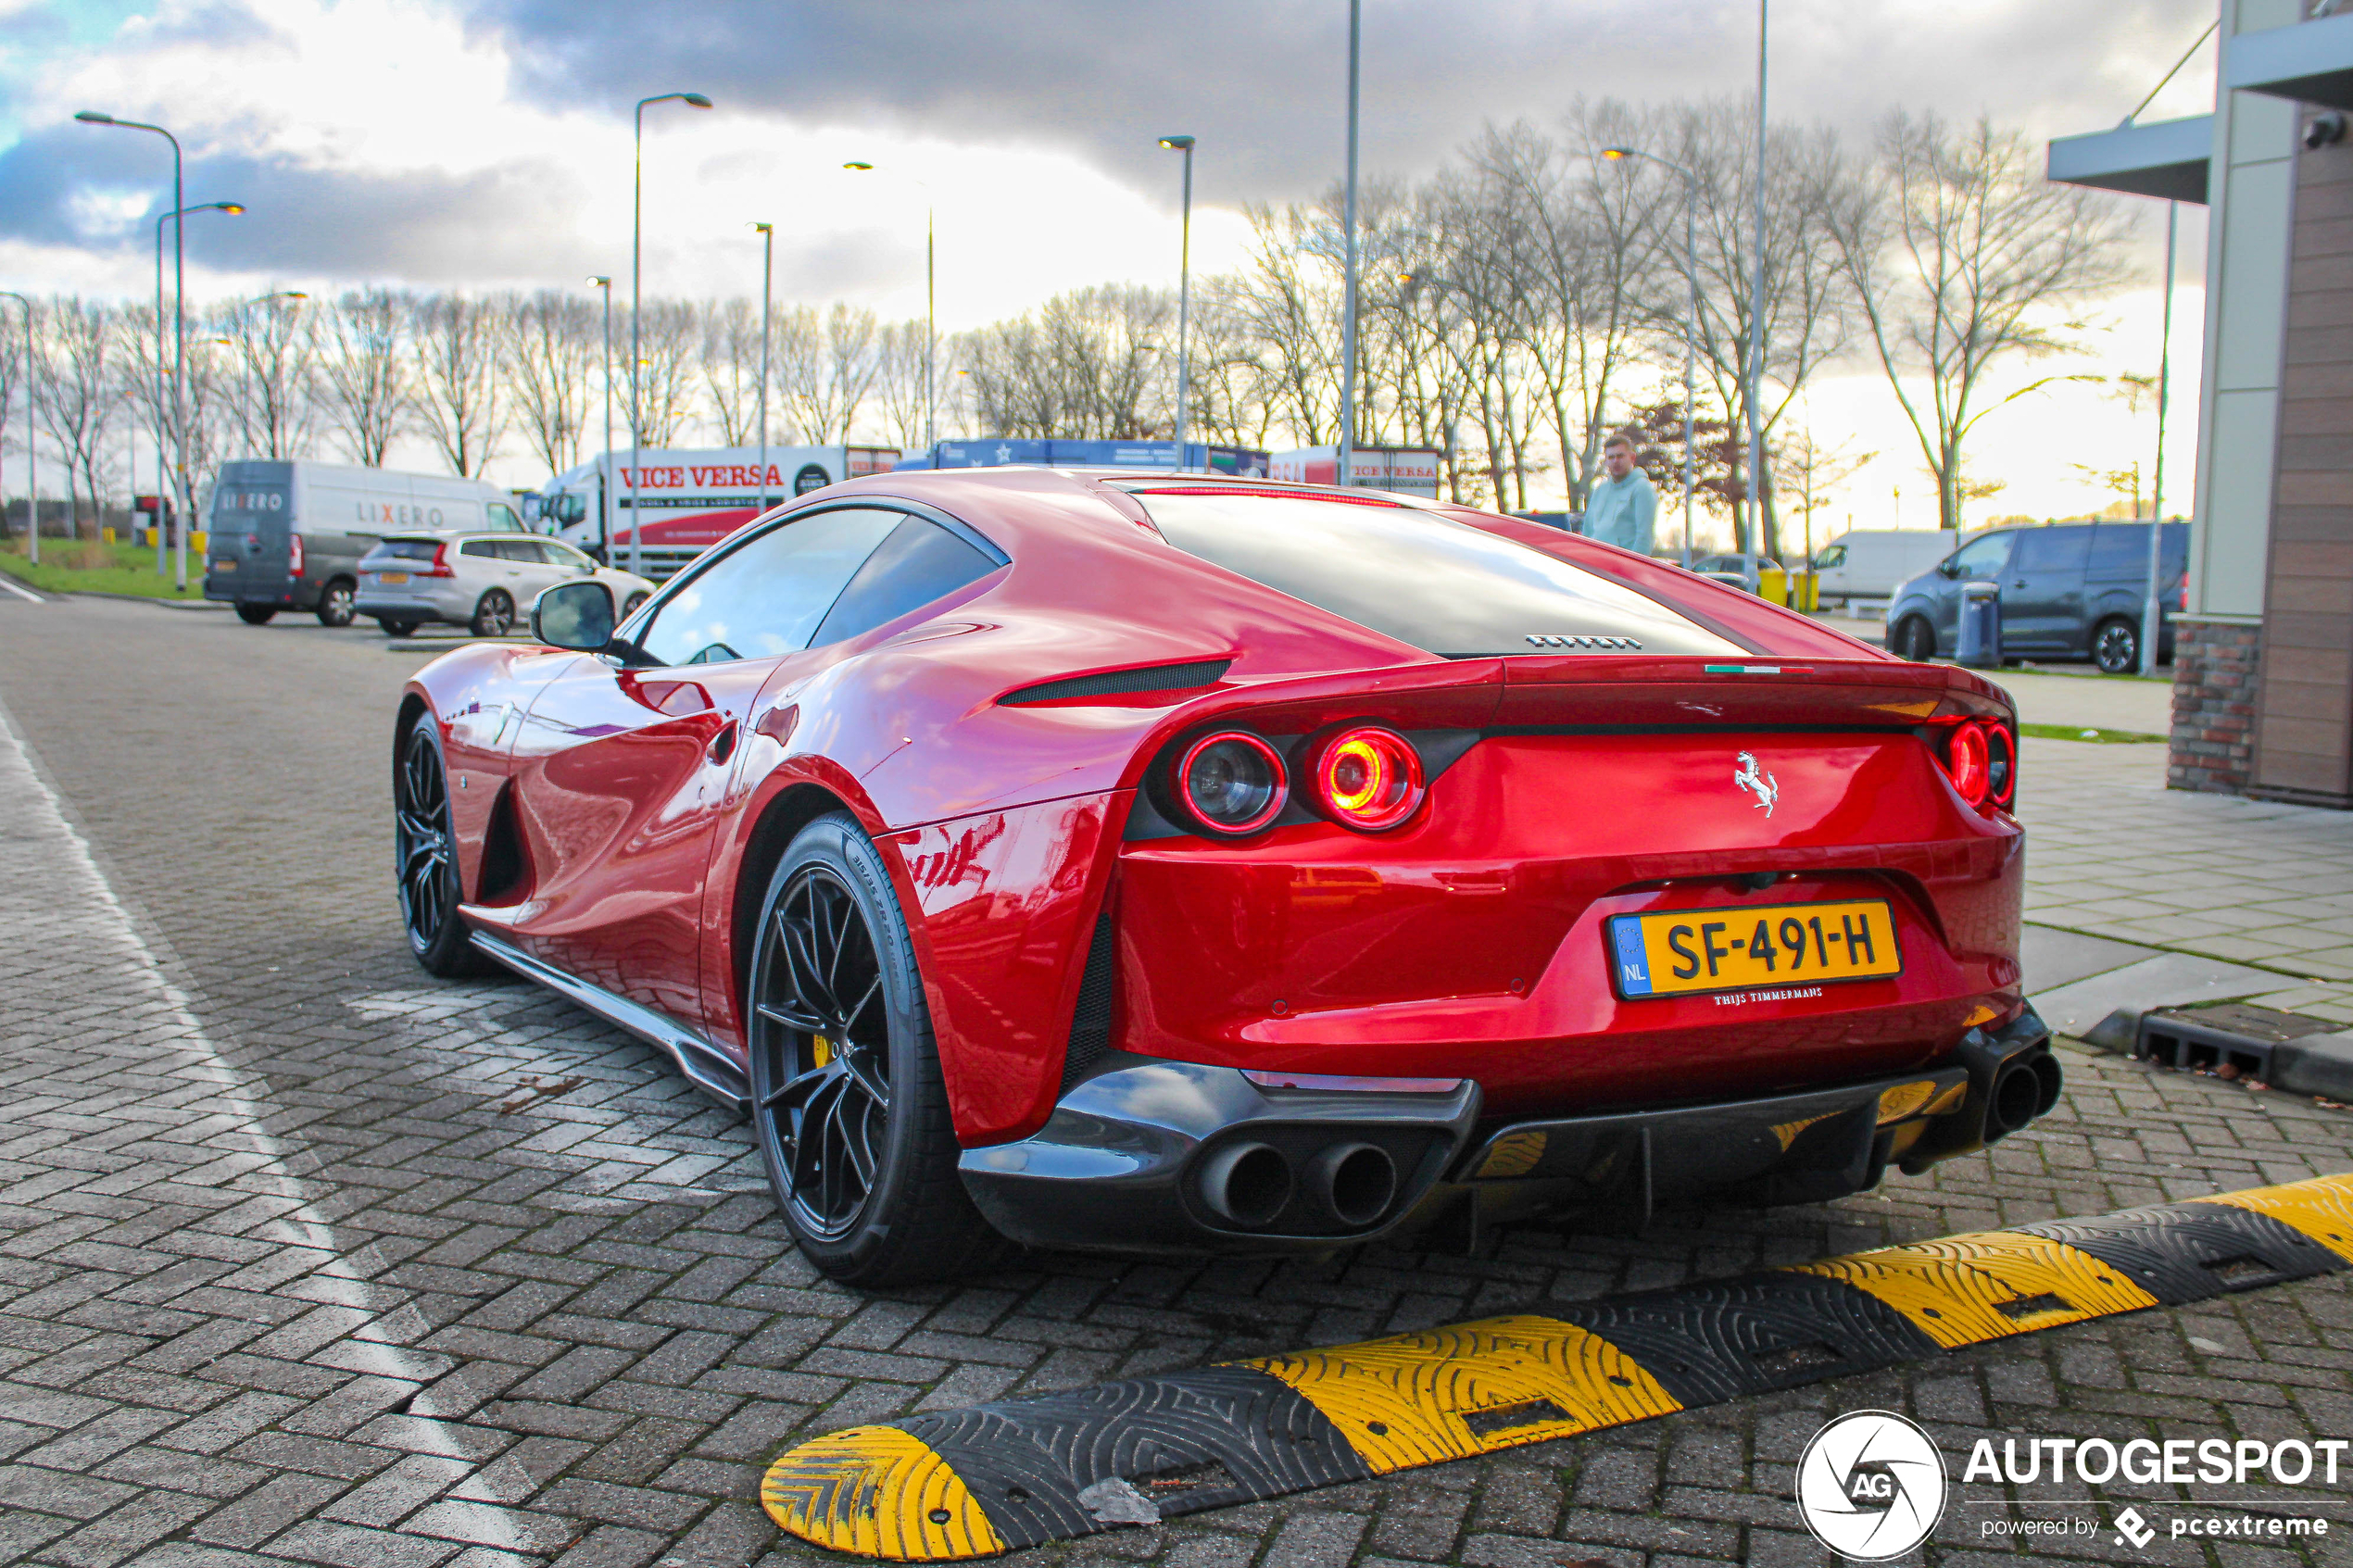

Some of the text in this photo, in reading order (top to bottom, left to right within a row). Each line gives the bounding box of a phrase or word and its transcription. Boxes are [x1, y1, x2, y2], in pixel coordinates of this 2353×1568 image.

[619, 467, 684, 488] VICE
[689, 464, 784, 487] VERSA
[223, 493, 283, 511] LIXERO
[358, 502, 444, 527] LIXERO
[1667, 913, 1877, 980] SF-491-H
[1624, 963, 1646, 982] NL
[1715, 987, 1823, 1006] THIJS TIMMERMANS
